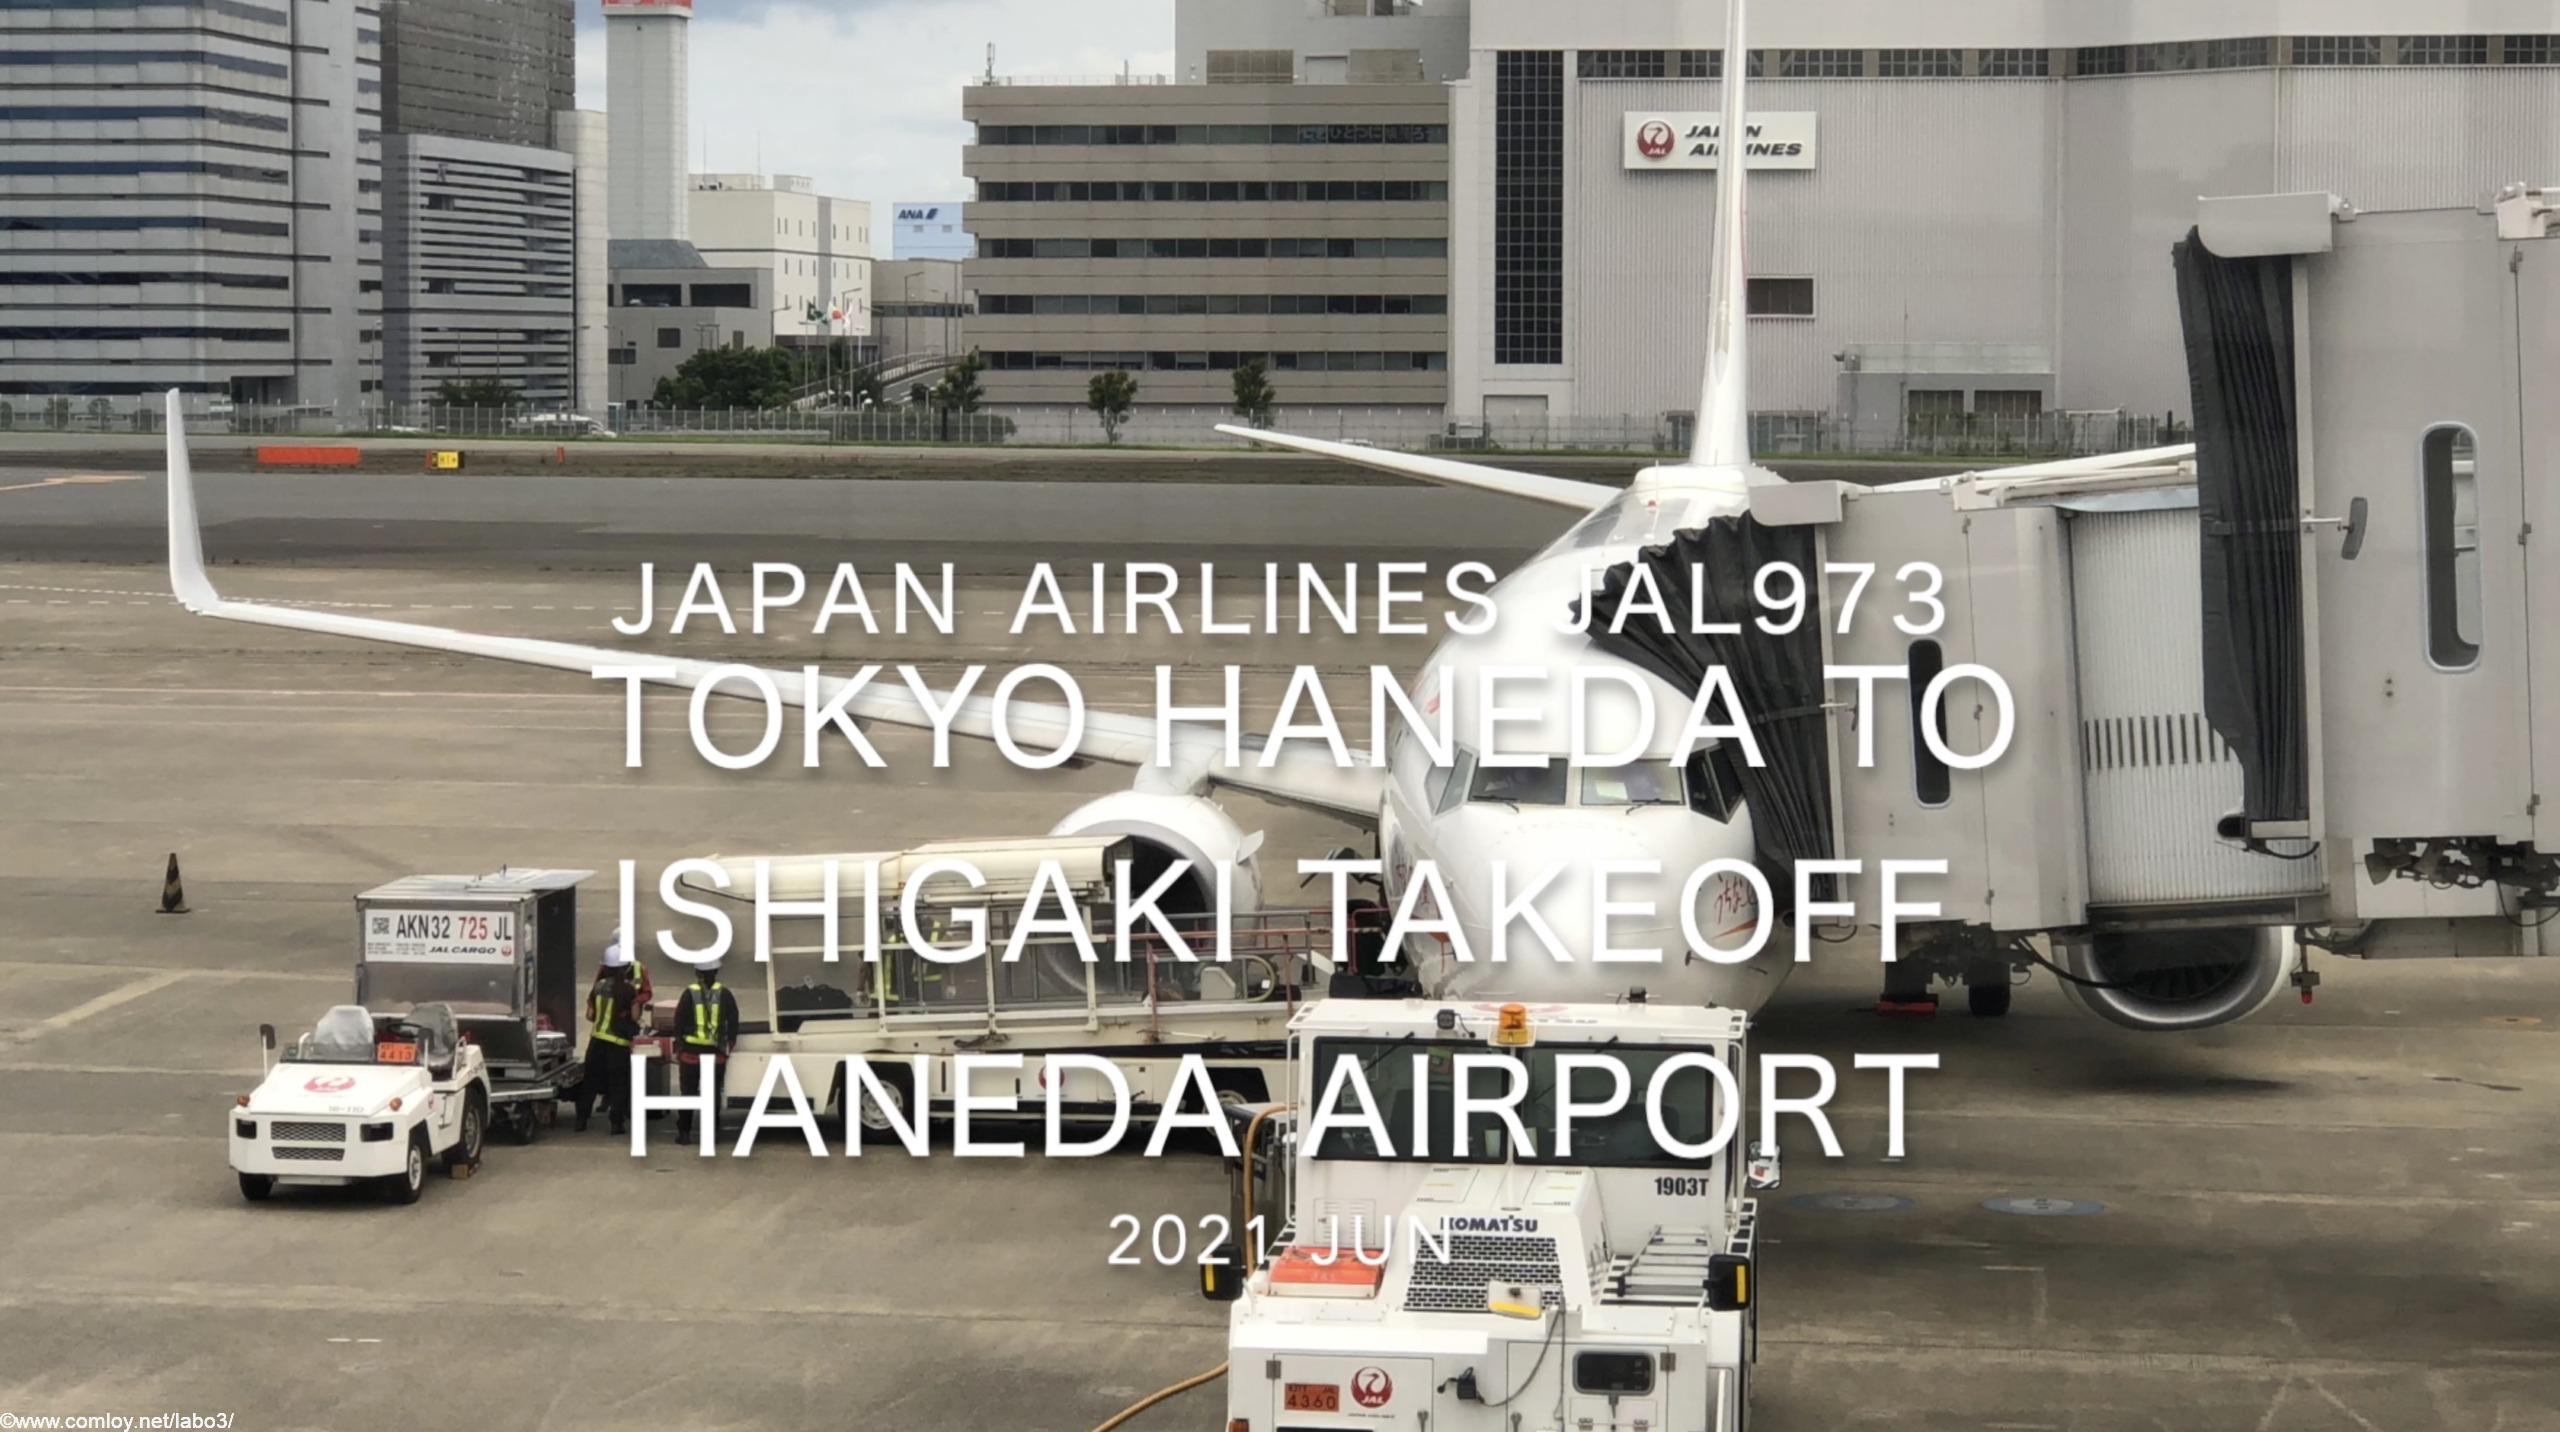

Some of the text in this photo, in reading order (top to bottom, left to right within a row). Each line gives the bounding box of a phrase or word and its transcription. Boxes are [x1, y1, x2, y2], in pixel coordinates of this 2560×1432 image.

[1685, 125, 1762, 138] JAN
[1689, 143, 1802, 156] AIINES
[898, 209, 923, 219] ANA
[458, 916, 488, 940] 725
[494, 917, 512, 940] JL
[452, 946, 496, 954] CARGO
[1655, 1177, 1709, 1196] 1903T
[1288, 1394, 1336, 1410] 4360
[1361, 1396, 1385, 1404] JAL
